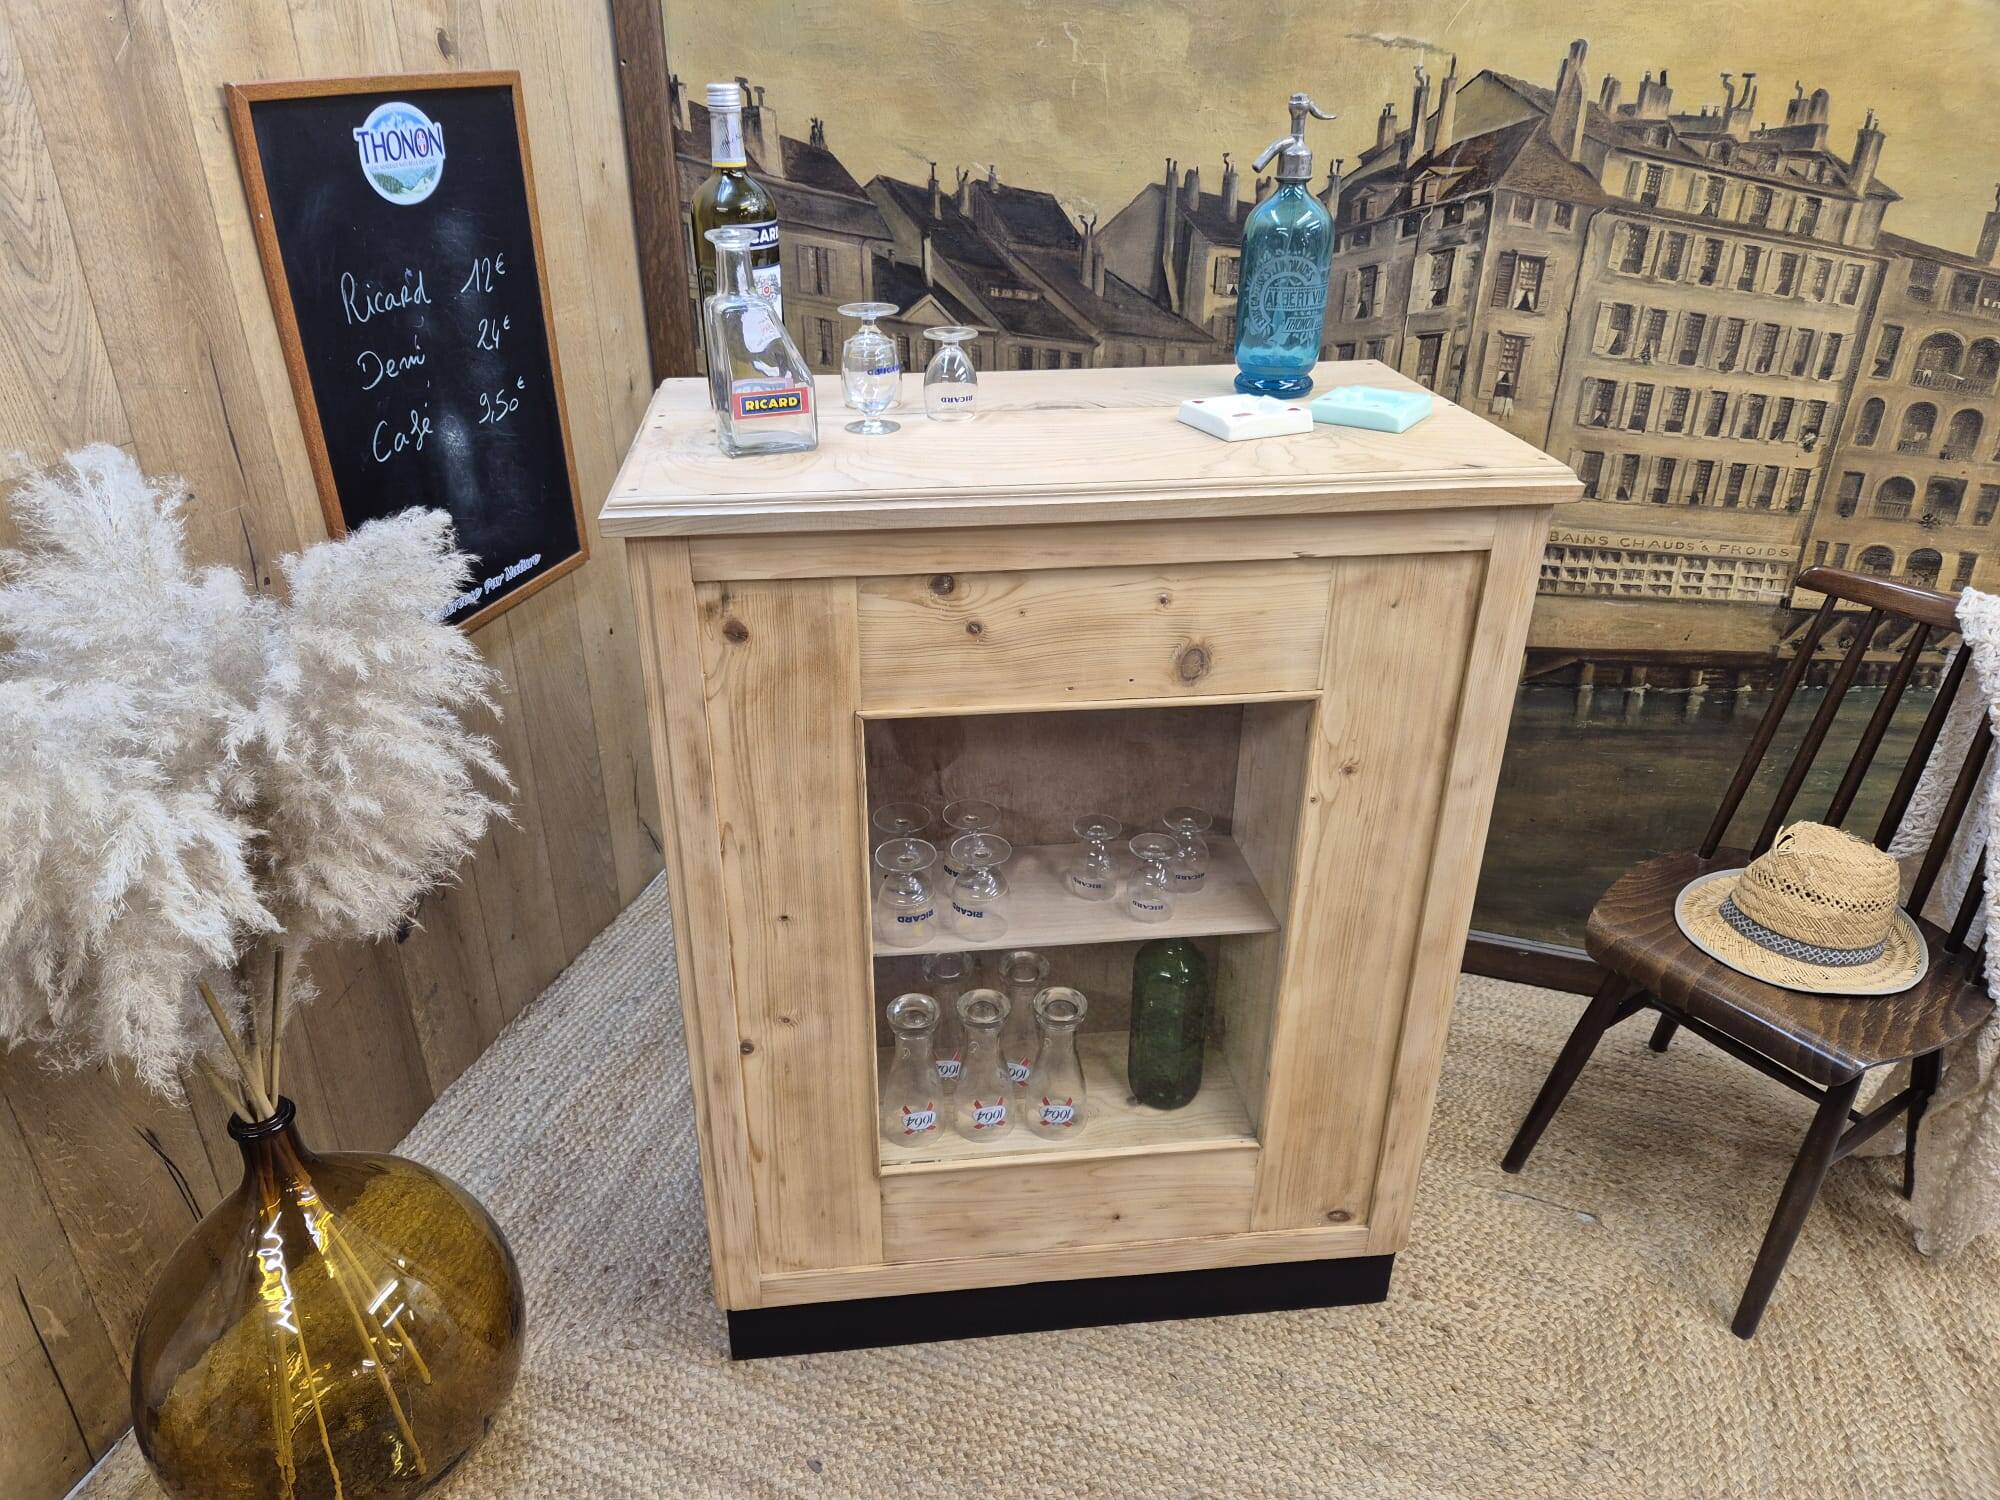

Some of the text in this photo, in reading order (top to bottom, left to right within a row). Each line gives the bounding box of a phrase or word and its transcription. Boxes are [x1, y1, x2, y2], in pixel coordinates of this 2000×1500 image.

[357, 127, 443, 164] THONON
[340, 253, 506, 325] Ricard 12€
[1265, 290, 1310, 307] ALBERT
[357, 315, 511, 390] Demi 24€
[745, 396, 799, 411] RICARD
[940, 395, 974, 404] RICARD
[373, 402, 433, 463] Café
[1549, 531, 1609, 546] BAINS
[1619, 537, 1695, 552] CHAUDS
[1717, 544, 1790, 557] FROIDS
[1073, 876, 1102, 889] RICARD
[1175, 872, 1205, 881] RICARD
[1132, 899, 1164, 911] RICARD
[897, 908, 934, 923] RICARD
[905, 1112, 933, 1127] 1664
[977, 1108, 1004, 1122] 1664
[1044, 1108, 1072, 1121] 1664
